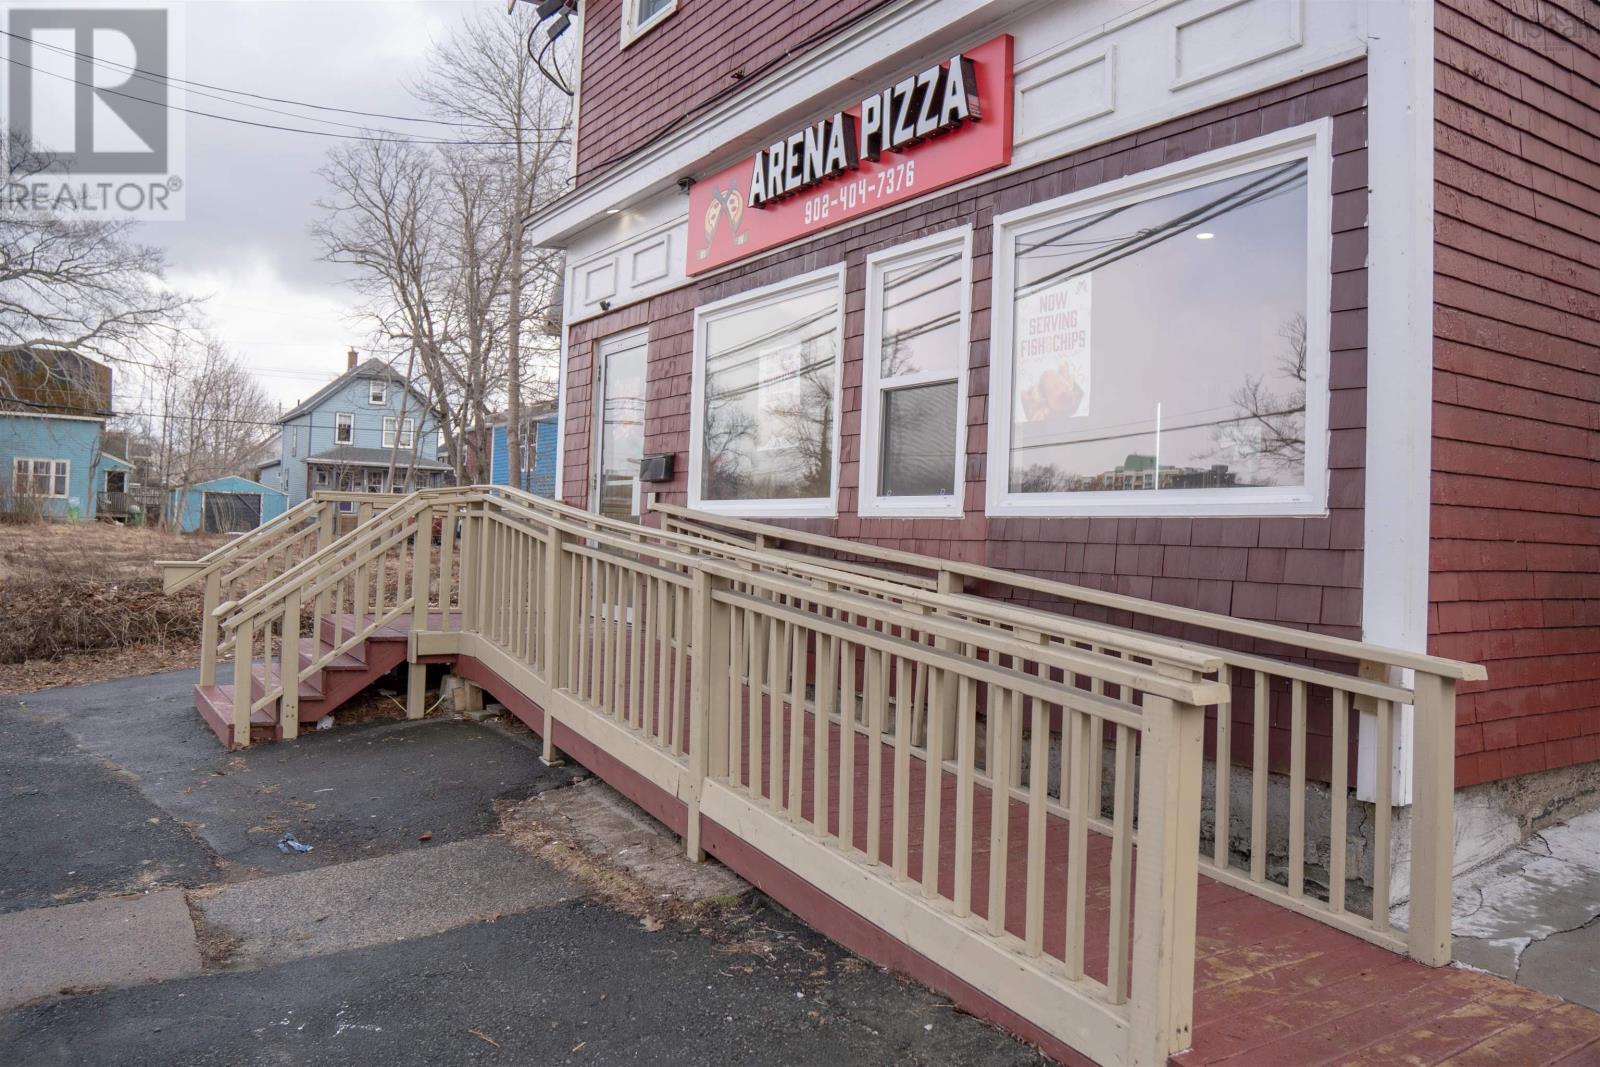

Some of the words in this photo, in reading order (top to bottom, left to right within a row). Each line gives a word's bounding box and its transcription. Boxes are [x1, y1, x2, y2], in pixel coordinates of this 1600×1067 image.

[748, 111, 851, 208] ARENA
[860, 54, 974, 160] PIZZA
[804, 160, 915, 225] 902-404-7376
[1029, 310, 1078, 336] SERVING
[1039, 291, 1068, 313] NOW
